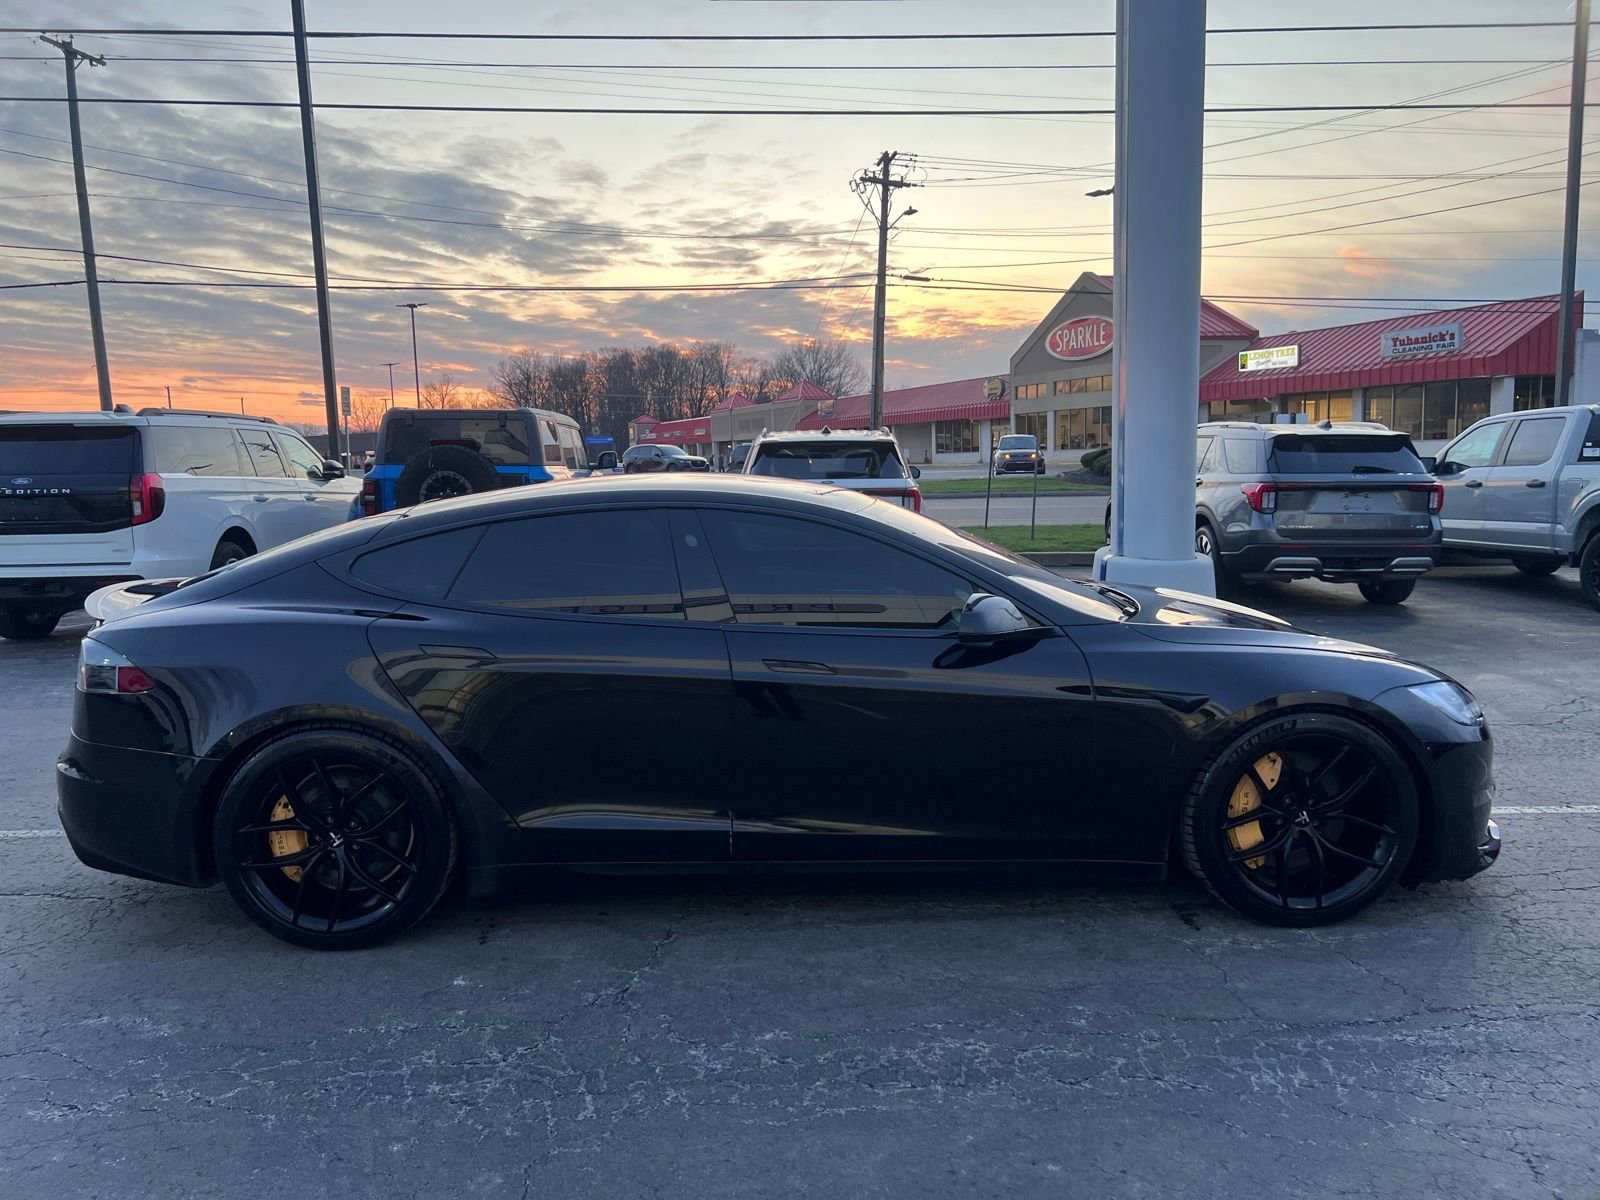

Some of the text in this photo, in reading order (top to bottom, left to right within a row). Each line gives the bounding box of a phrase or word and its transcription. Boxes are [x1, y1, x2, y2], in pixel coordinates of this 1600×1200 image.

[1055, 322, 1107, 352] SPARKLE
[1248, 347, 1296, 361] LEMON TREE
[1392, 342, 1456, 354] CLEANING FAIR
